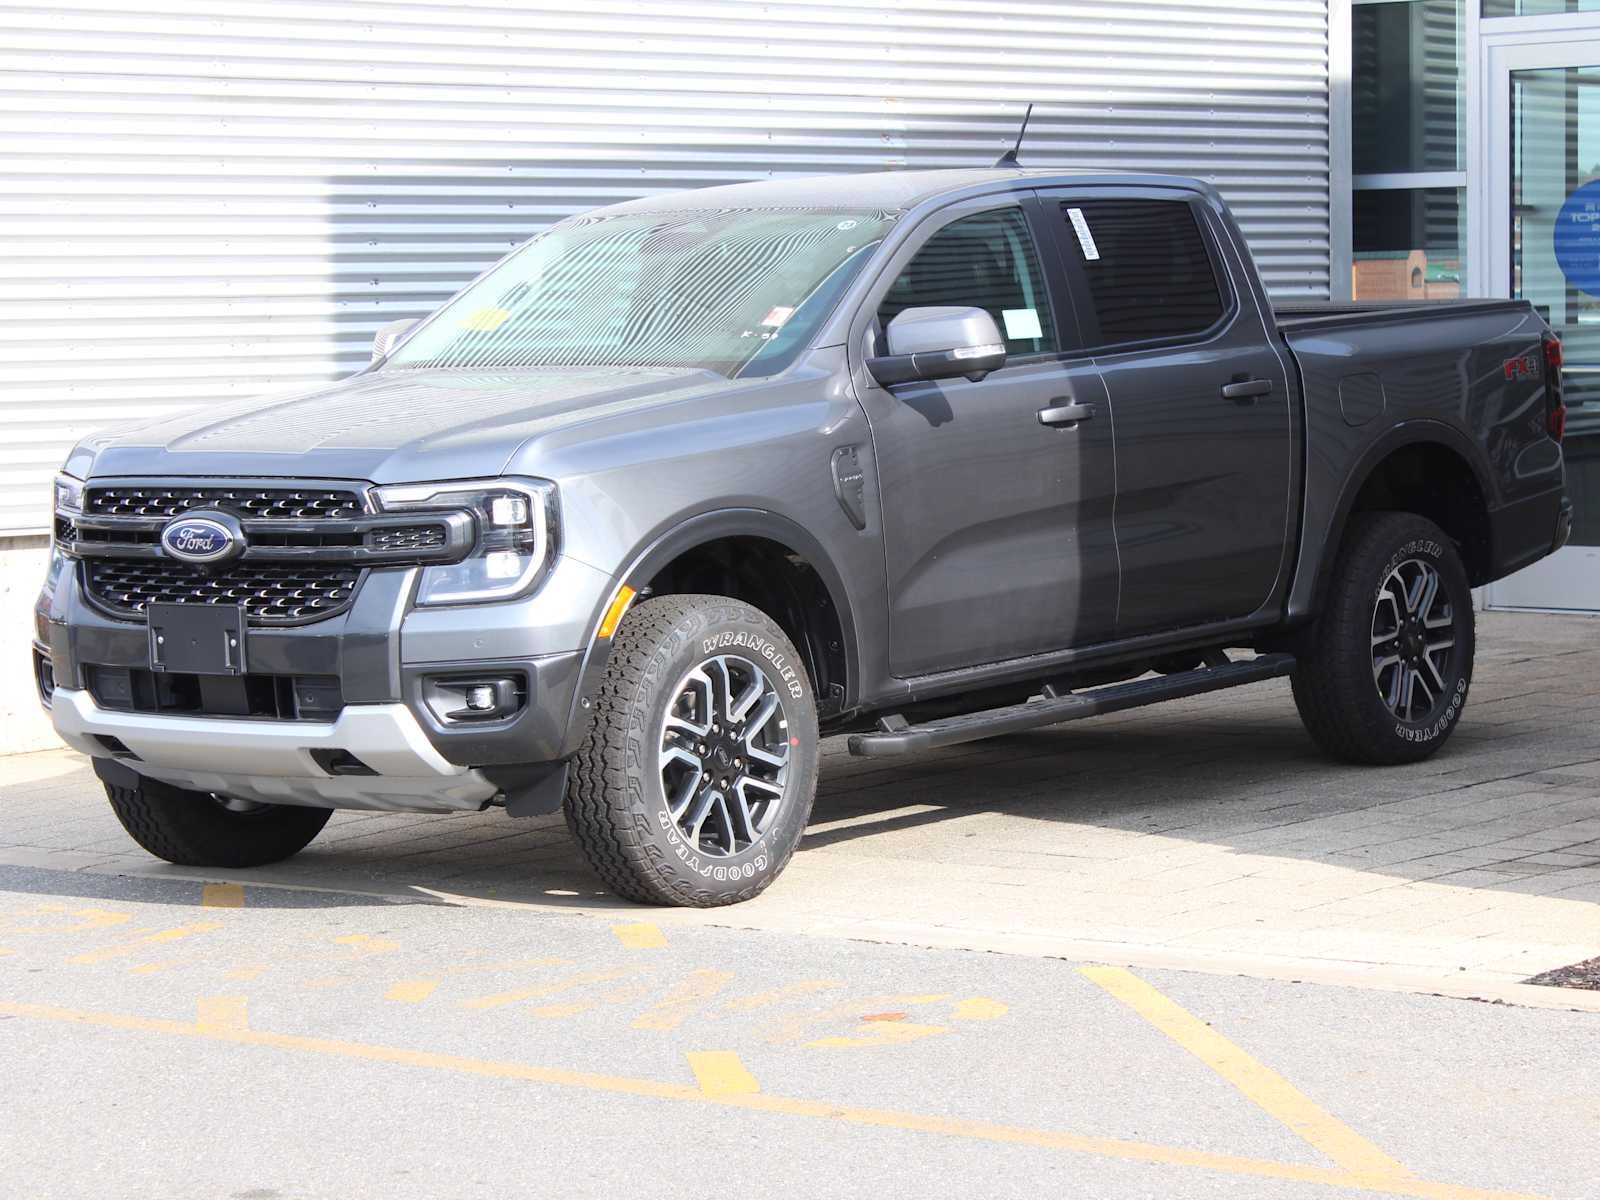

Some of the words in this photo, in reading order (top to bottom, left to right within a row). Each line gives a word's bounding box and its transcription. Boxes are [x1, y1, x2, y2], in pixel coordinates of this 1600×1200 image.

[176, 527, 216, 550] Ford
[702, 631, 803, 699] WRANGLER
[1395, 677, 1466, 742] GOODYEAR
[658, 810, 768, 881] GOODYEAR
